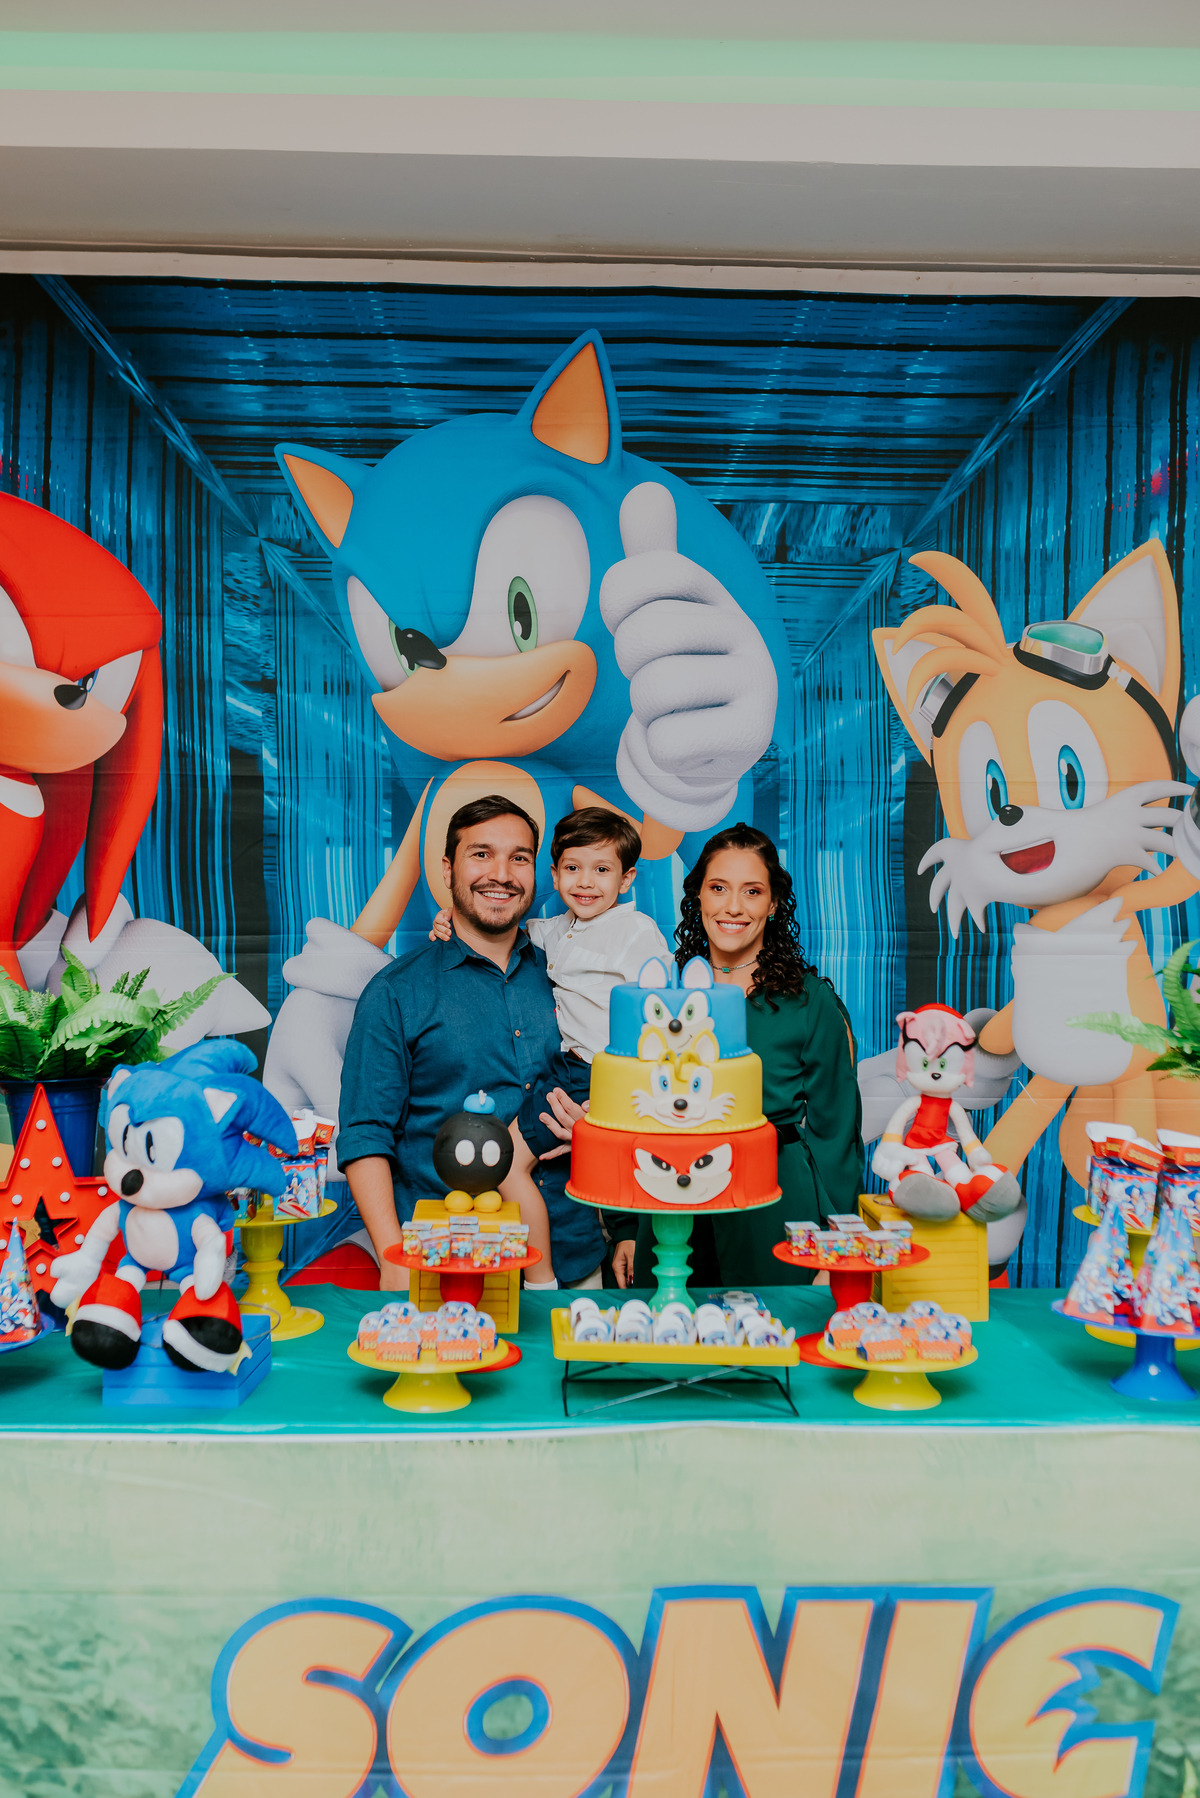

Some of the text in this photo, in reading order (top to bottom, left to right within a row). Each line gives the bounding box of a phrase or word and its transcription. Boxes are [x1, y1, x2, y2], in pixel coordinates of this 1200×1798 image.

[381, 1351, 413, 1361] SONIC
[441, 1350, 473, 1361] SONIC
[874, 1350, 903, 1361] SONIC
[922, 1351, 953, 1361] SONIC
[174, 1585, 1181, 1798] SONIC
